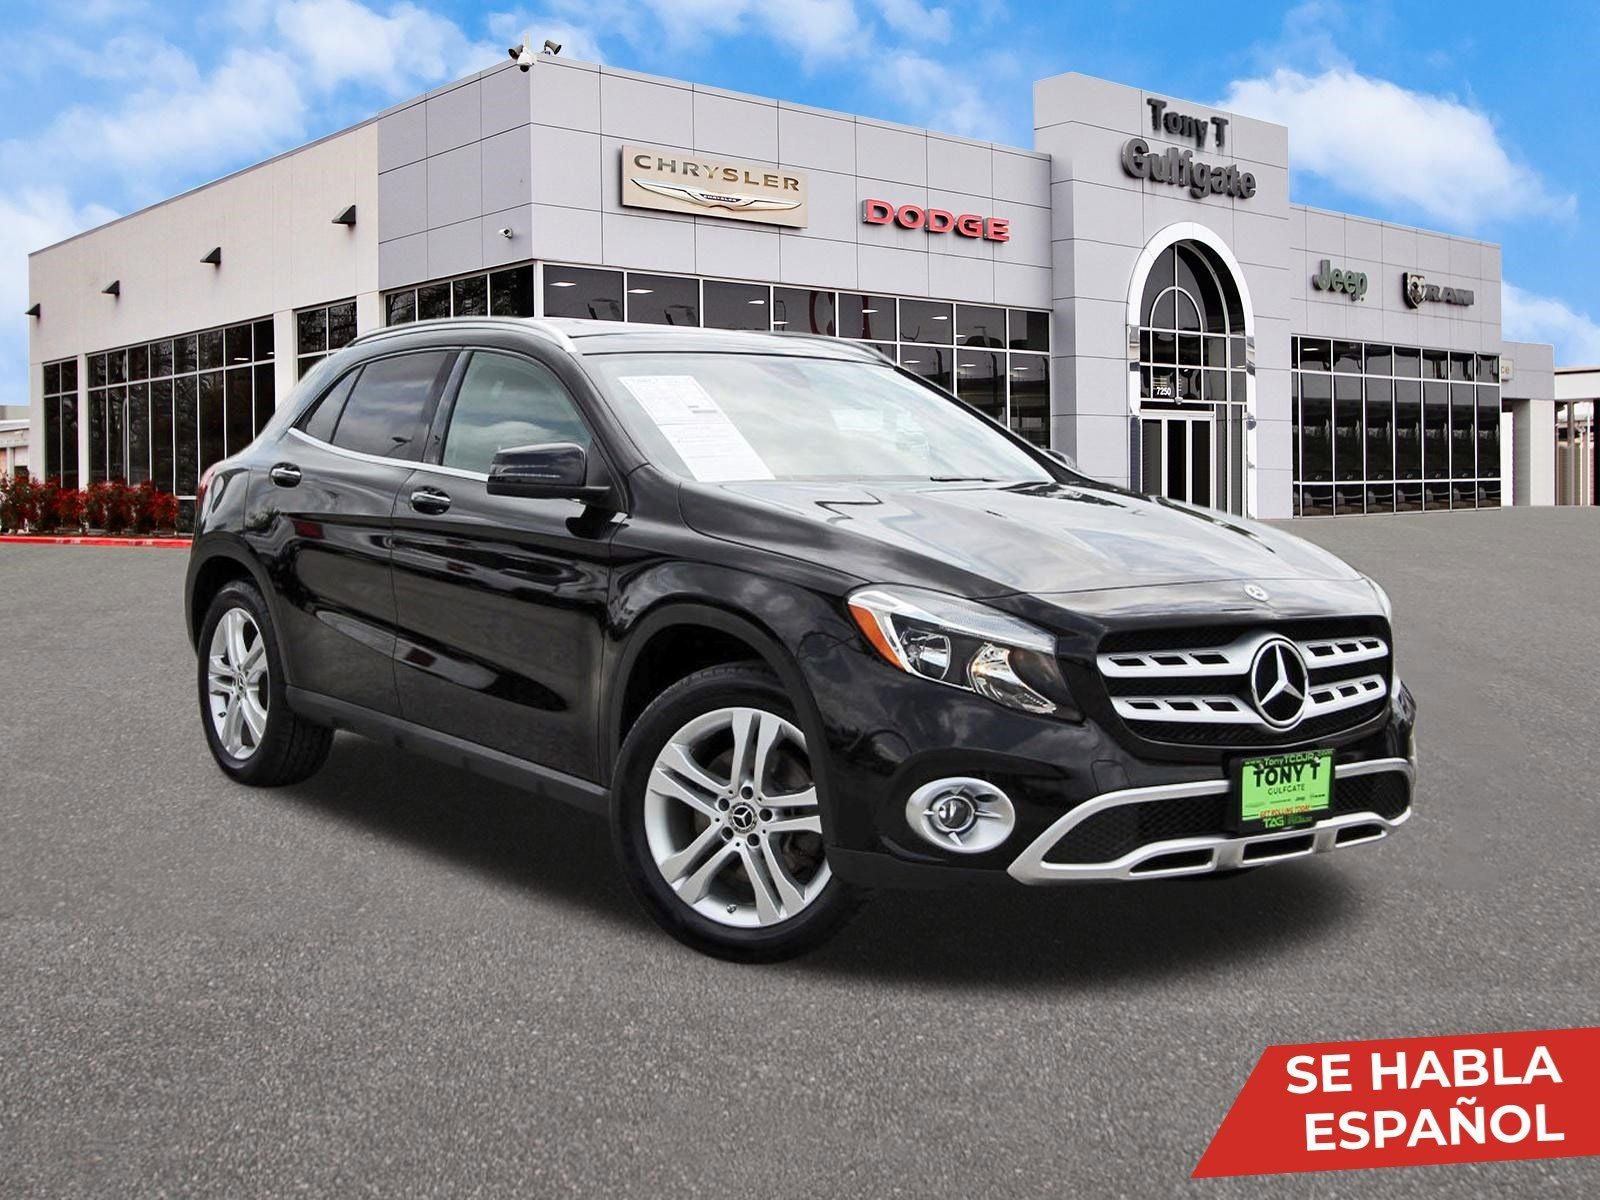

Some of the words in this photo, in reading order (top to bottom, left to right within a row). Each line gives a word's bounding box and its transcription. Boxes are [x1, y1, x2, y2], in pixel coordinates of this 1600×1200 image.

[1146, 98, 1208, 147] Tony
[1210, 116, 1229, 147] T
[634, 154, 800, 191] CHRYSLER
[1121, 138, 1257, 199] Gulfgate
[862, 199, 1010, 242] DODGE
[1312, 259, 1368, 301] Jeep
[1425, 284, 1474, 306] RAM
[1156, 386, 1172, 396] 7250
[1253, 764, 1306, 787] TONY
[1310, 761, 1321, 780] T
[1267, 783, 1306, 795] GULFGATE
[1263, 816, 1285, 828] TAG
